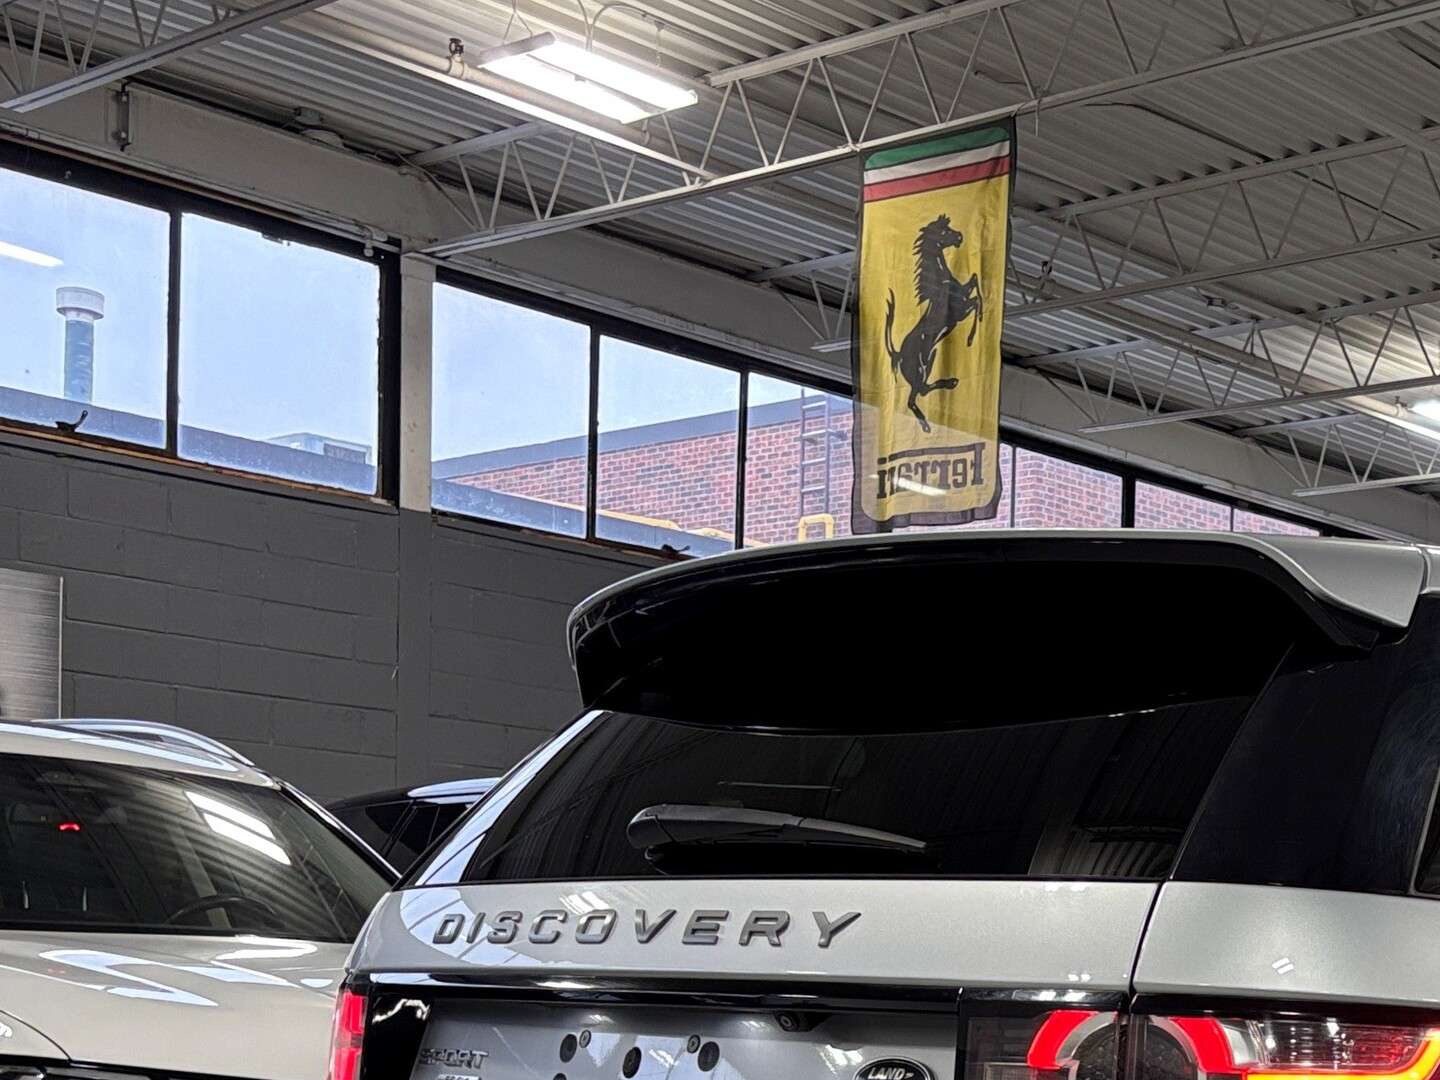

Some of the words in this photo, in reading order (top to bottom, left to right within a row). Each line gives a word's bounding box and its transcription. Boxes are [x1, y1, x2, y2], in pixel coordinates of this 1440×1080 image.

[432, 908, 862, 948] DISCOVERY
[420, 1048, 489, 1069] SPORT
[867, 1067, 906, 1080] LAND
